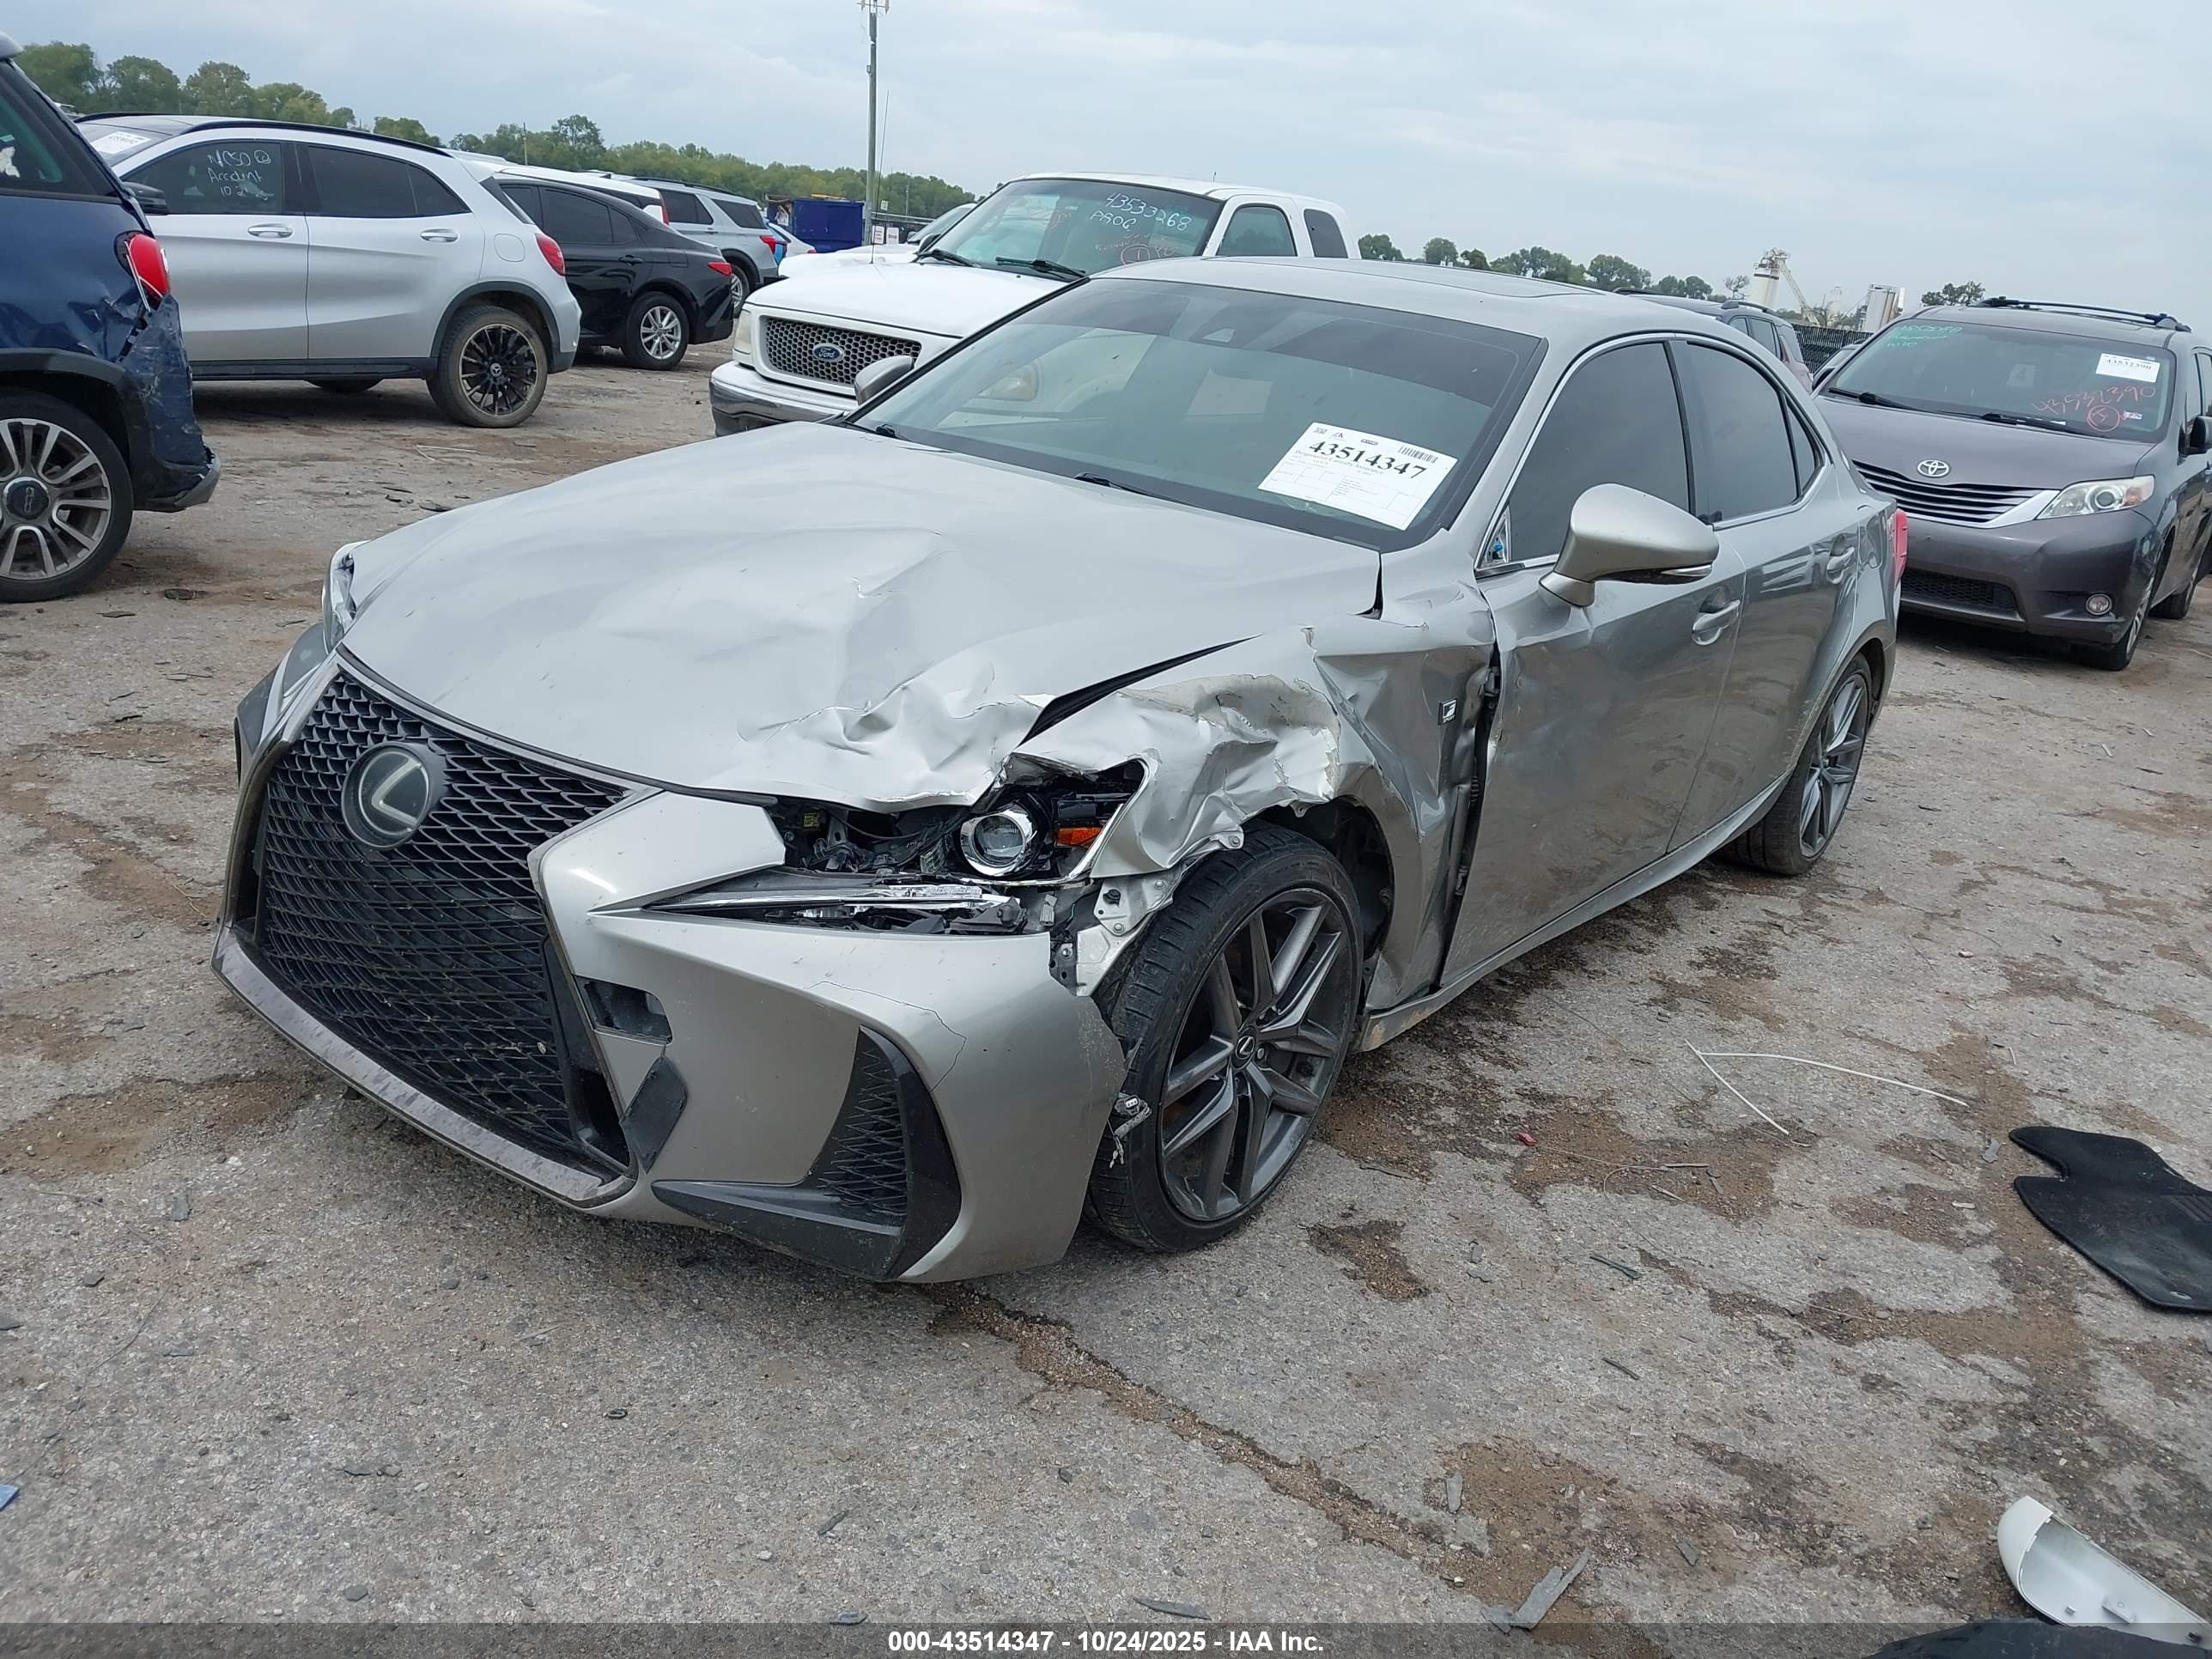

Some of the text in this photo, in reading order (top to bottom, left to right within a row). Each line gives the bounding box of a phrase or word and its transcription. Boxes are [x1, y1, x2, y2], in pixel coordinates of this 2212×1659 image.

[1105, 191, 1192, 231] 43533268
[818, 348, 836, 358] Ford
[1309, 441, 1428, 478] 43514347
